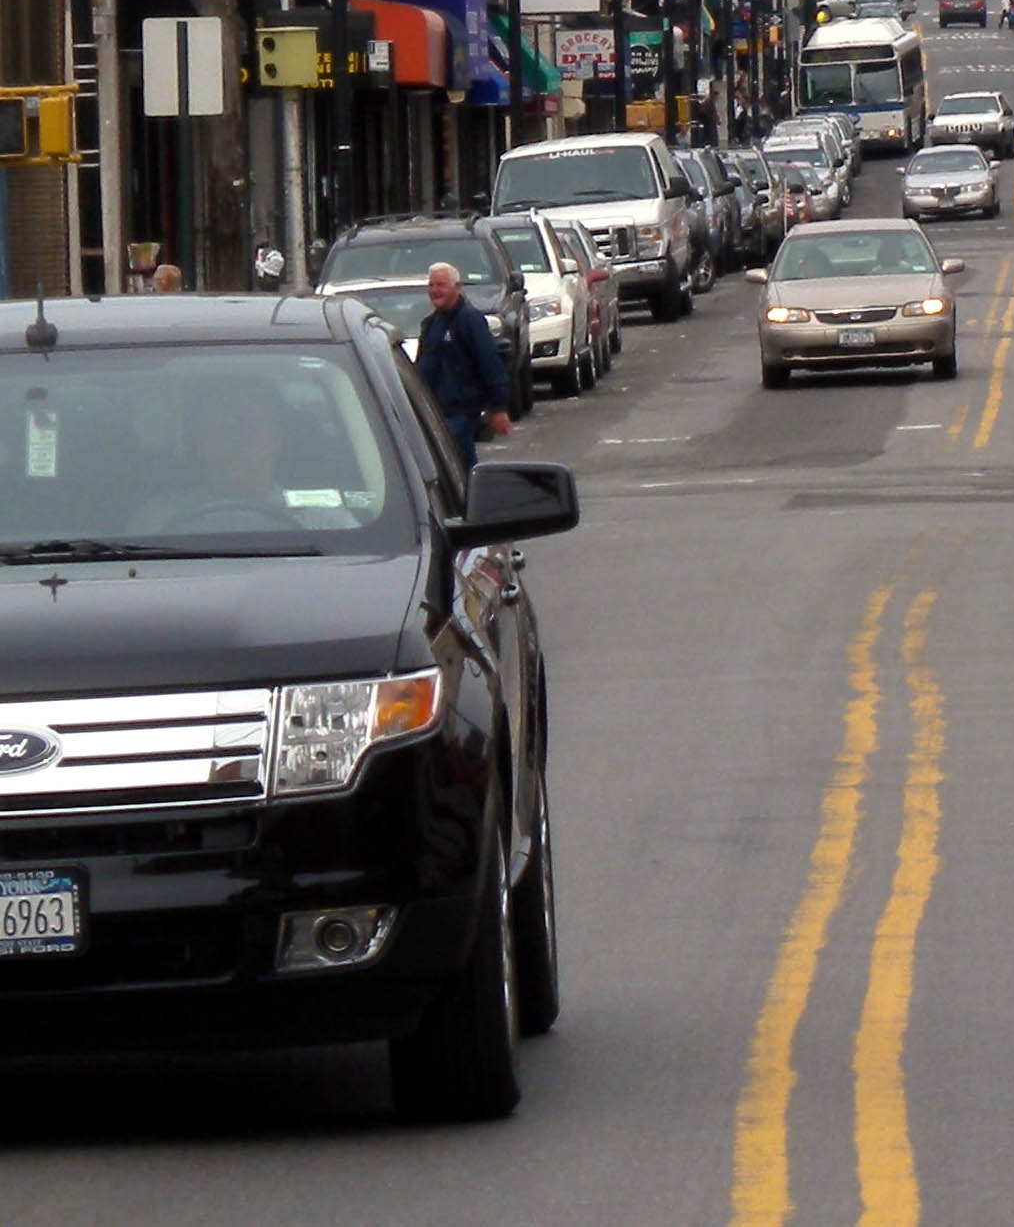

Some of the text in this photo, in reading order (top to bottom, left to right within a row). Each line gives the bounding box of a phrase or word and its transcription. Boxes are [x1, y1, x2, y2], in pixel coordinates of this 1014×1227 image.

[560, 32, 615, 53] GROCERY
[549, 149, 596, 160] U-HAUL
[0, 734, 28, 758] rd
[3, 894, 65, 937] 6963
